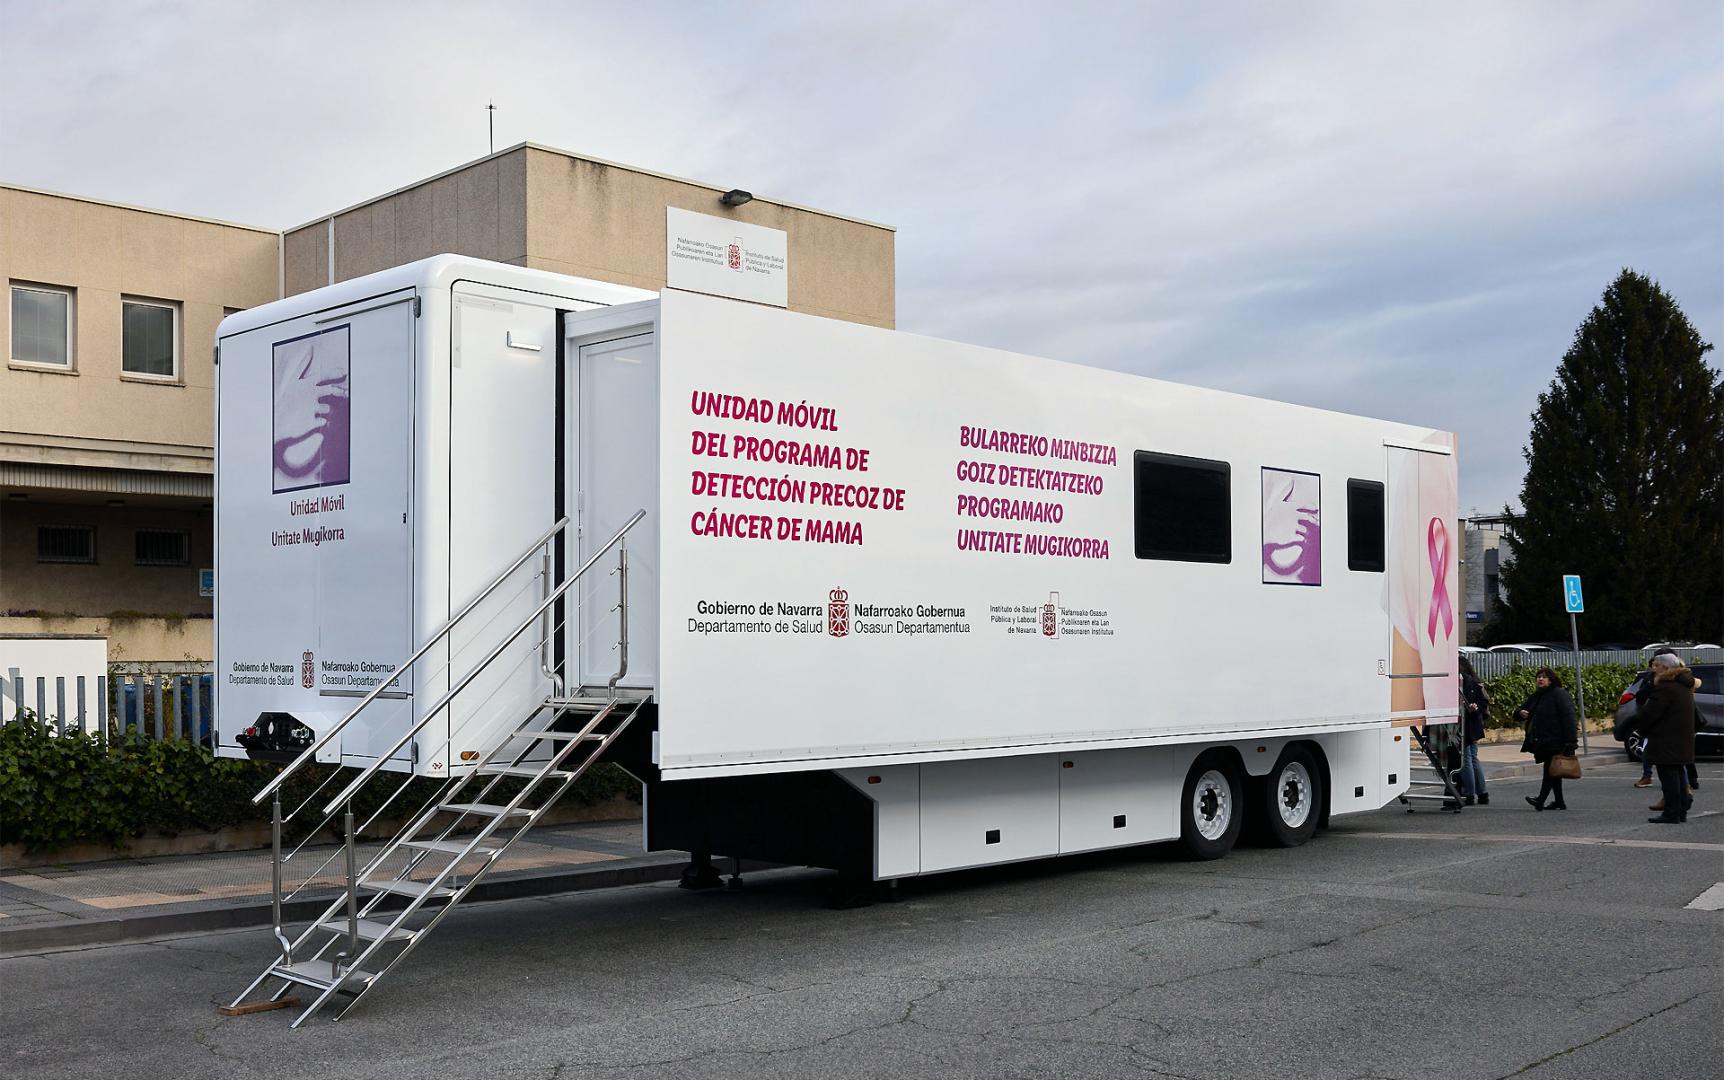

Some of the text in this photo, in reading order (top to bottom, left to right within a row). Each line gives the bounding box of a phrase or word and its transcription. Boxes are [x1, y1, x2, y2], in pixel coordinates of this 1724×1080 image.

[691, 390, 838, 432] UNIDAD MÓVIL
[691, 431, 870, 472] DEL PROGRAMA DE
[960, 425, 1117, 467] BULARREKO MINBIZIA
[956, 459, 1104, 496] GOIZ DETEKTATZEKO
[691, 471, 906, 511] DETECCIÓN PRECOZ DE
[290, 494, 345, 516] Unidad Móvil
[957, 494, 1064, 524] PROGRAMAKO
[691, 507, 863, 546] CÁNCER DE MAMA
[271, 525, 345, 547] Unitate Mugikorra
[957, 529, 1110, 560] UNITATE MUGIKORRA
[697, 600, 823, 617] Gobierno de Navarra
[854, 604, 966, 618] Nafarroako Gobernua
[990, 605, 1037, 614] Instituto de Salud
[1089, 609, 1108, 617] Osasun
[688, 618, 823, 636] Departamento de Salud
[854, 620, 971, 637] Osasun Departamentua
[1012, 616, 1016, 625] y
[1017, 616, 1037, 624] Laboral
[1100, 619, 1110, 627] Lan
[1007, 626, 1037, 634] de Navarra
[232, 662, 294, 673] Gobierno de Navarra
[321, 661, 396, 673] Nafarroako Gobernua
[229, 673, 294, 686] Departamento de Salud
[321, 674, 346, 685] Osasun
